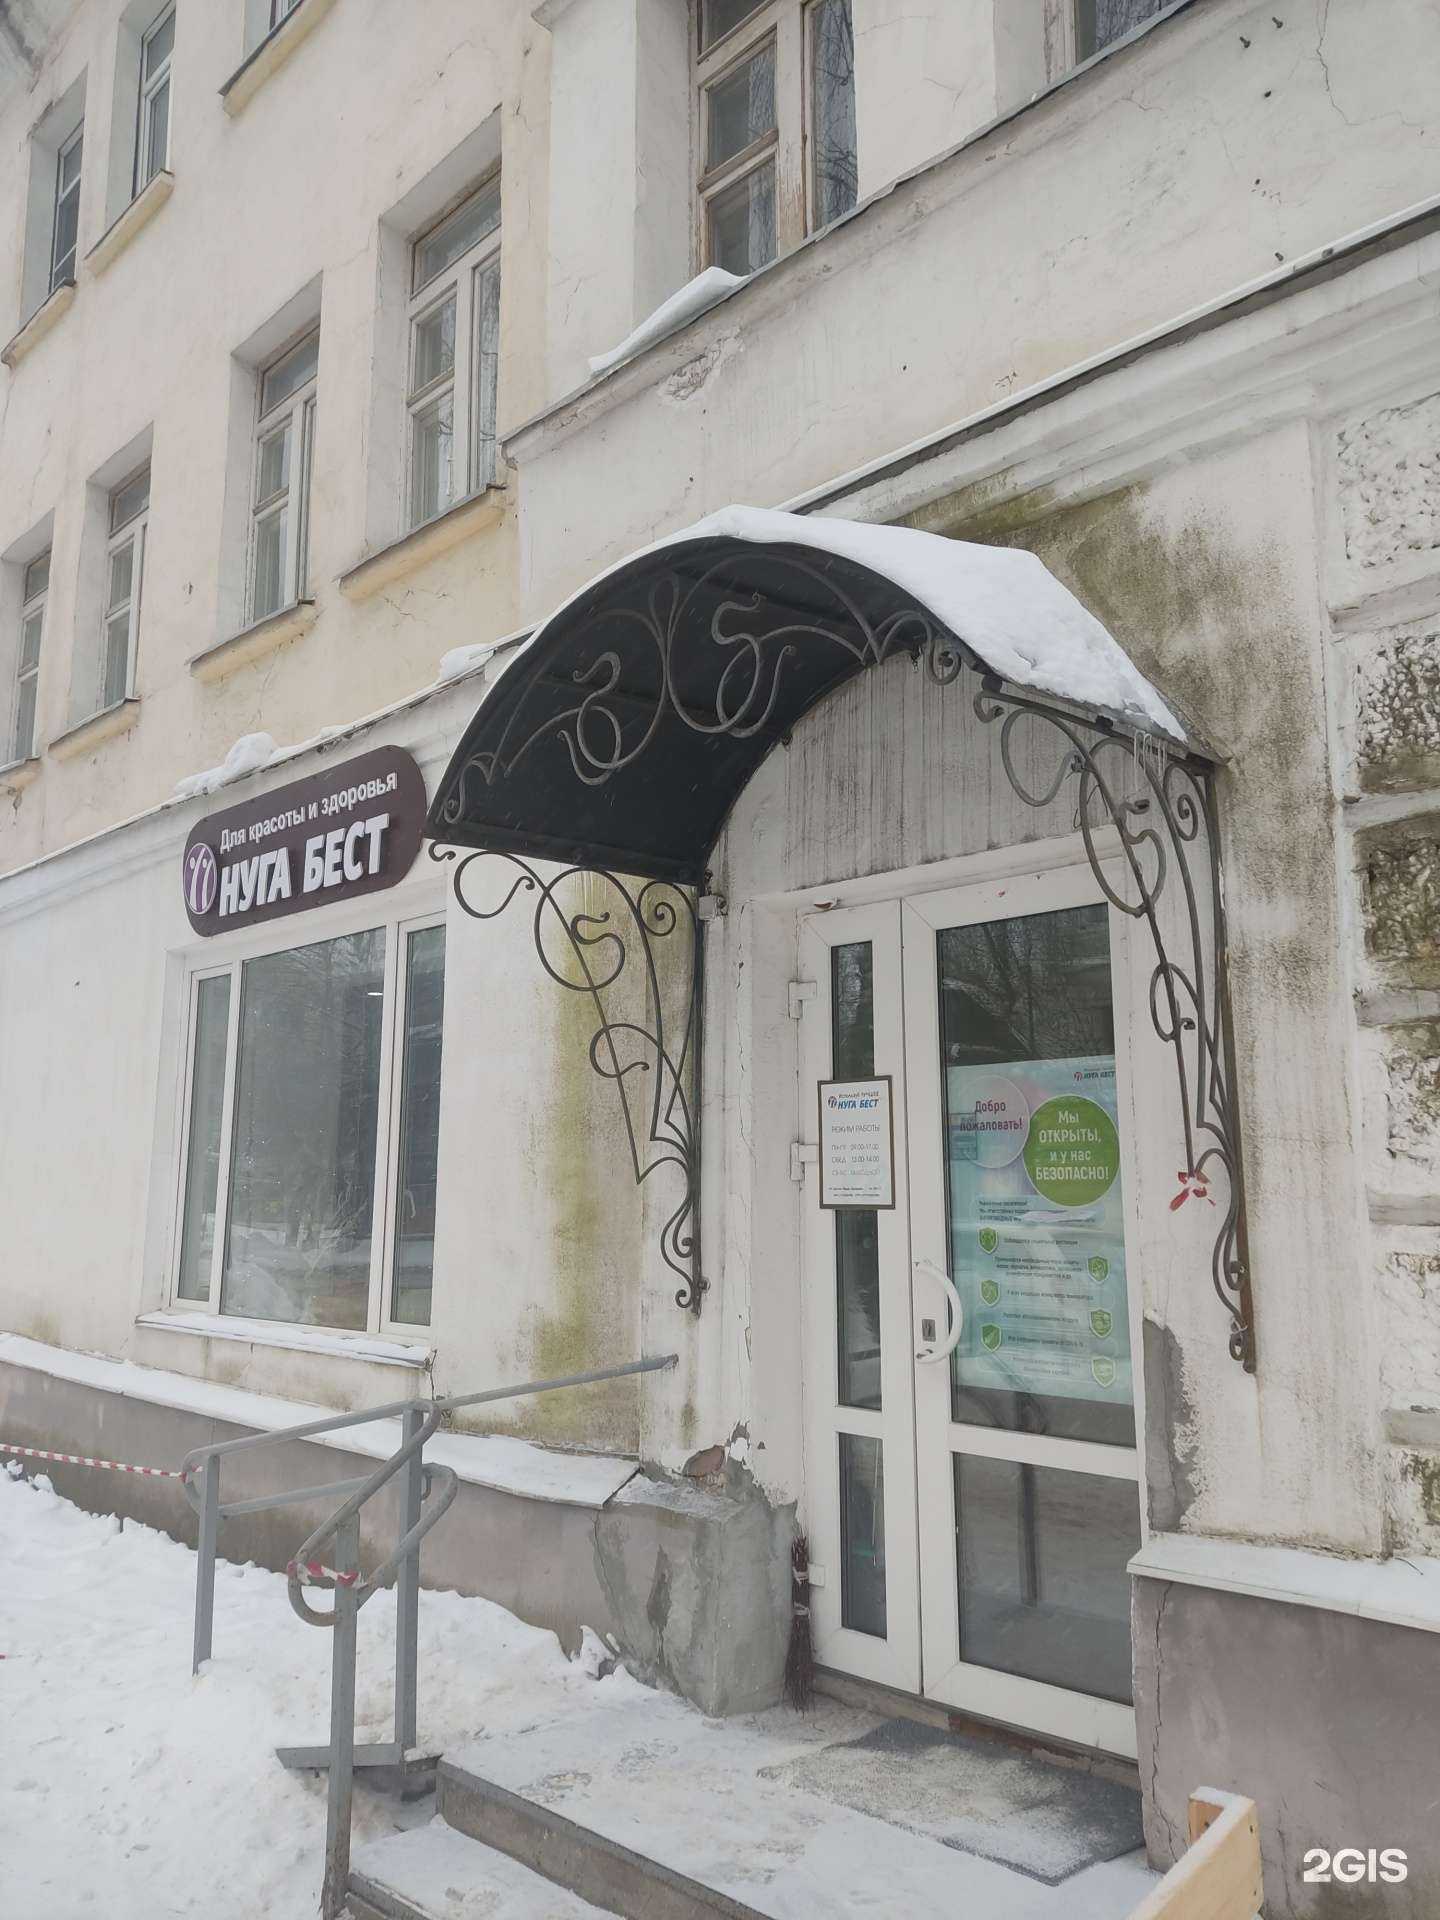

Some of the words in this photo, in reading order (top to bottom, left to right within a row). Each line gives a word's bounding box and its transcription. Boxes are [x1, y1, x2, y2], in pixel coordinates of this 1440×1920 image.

[220, 829, 246, 854] Для
[249, 808, 305, 843] красоты
[308, 801, 319, 819] и
[321, 772, 398, 816] здоровья
[219, 847, 292, 917] НУГА
[303, 813, 389, 894] БЕСТ
[838, 1100, 857, 1110] НУГА
[860, 1099, 880, 1108] БЕСТ
[975, 1101, 1006, 1114] Добро
[960, 1117, 1023, 1131] пожаловать!
[1058, 1111, 1079, 1124] Мы
[1039, 1128, 1102, 1143] ОТКРЫТЫ,
[1050, 1151, 1059, 1162] и
[1061, 1151, 1070, 1163] у
[1072, 1150, 1092, 1161] нас
[1036, 1166, 1109, 1181] БЕЗОПАСНО!
